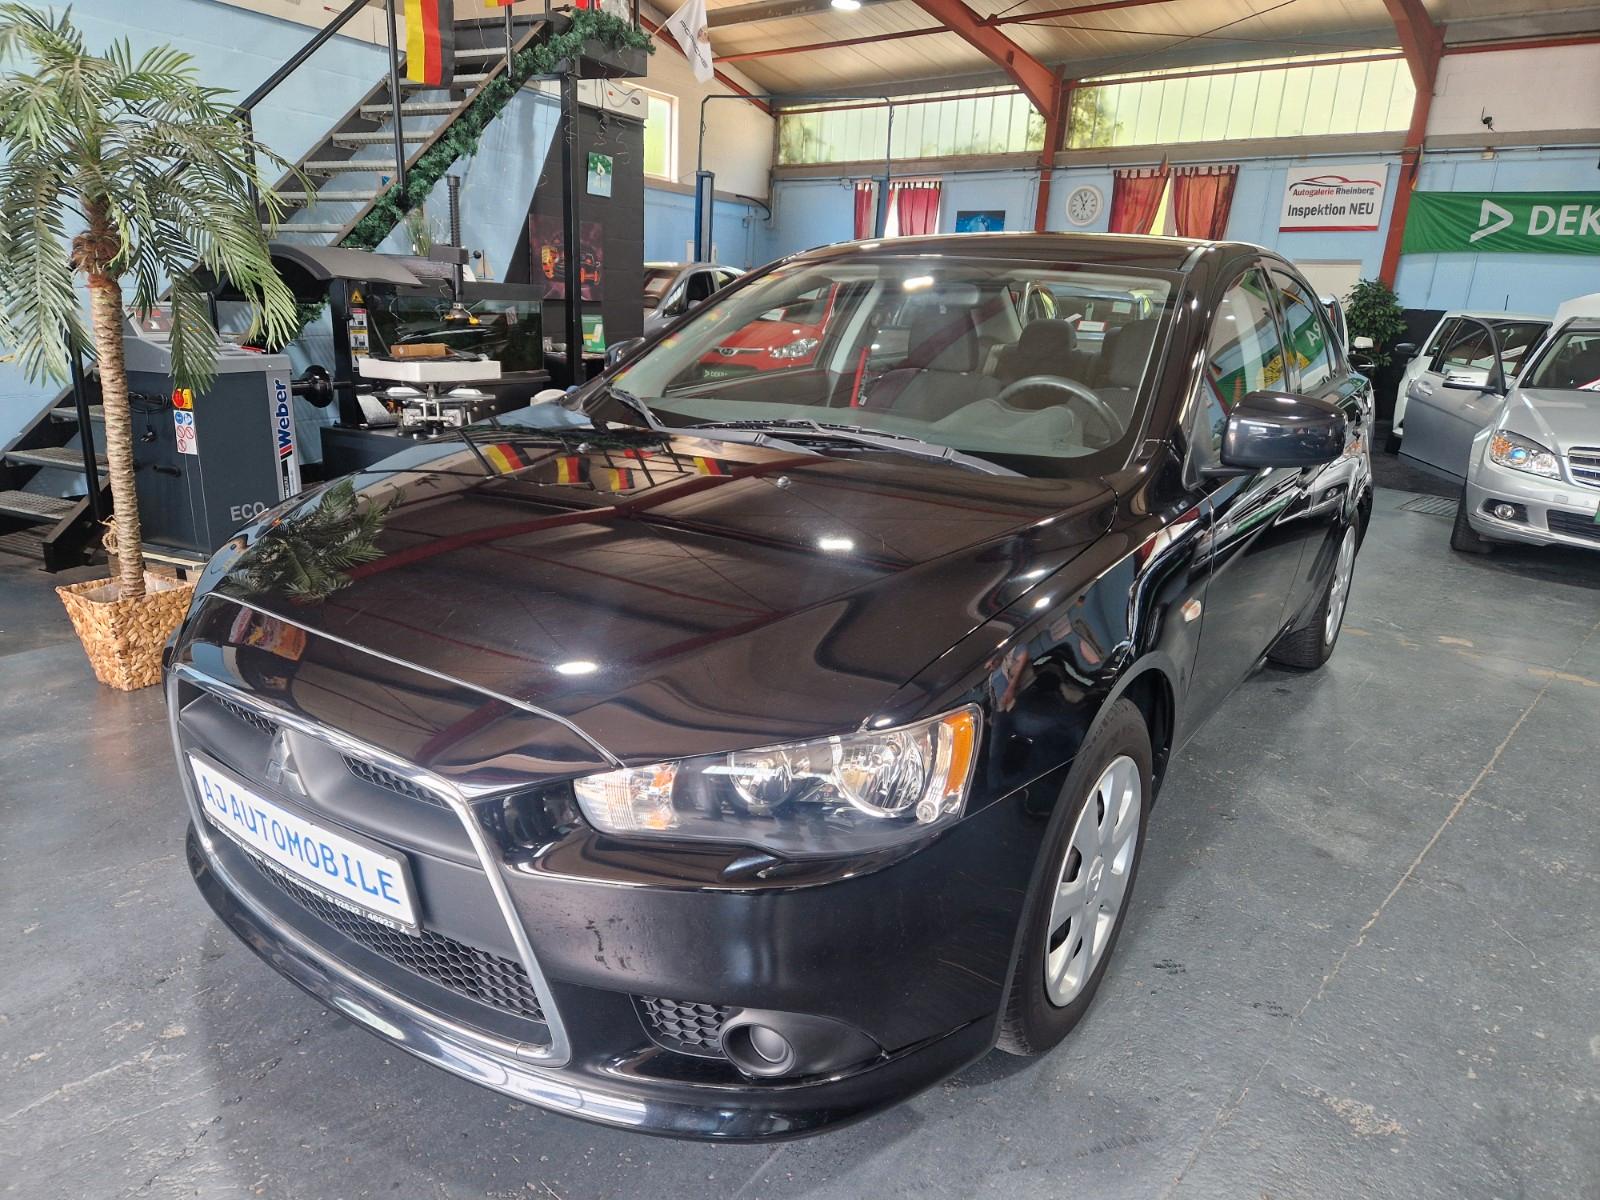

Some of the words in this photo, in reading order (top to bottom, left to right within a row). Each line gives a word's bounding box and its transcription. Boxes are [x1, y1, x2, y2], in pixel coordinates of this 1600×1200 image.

[1292, 188, 1334, 197] Autogalerie
[1335, 186, 1375, 196] Rheinberg
[1287, 203, 1346, 219] Inspektion
[1349, 202, 1375, 215] NEU
[275, 378, 292, 448] Weber
[230, 501, 265, 521] ECO
[230, 793, 401, 905] AUTOMOBILE
